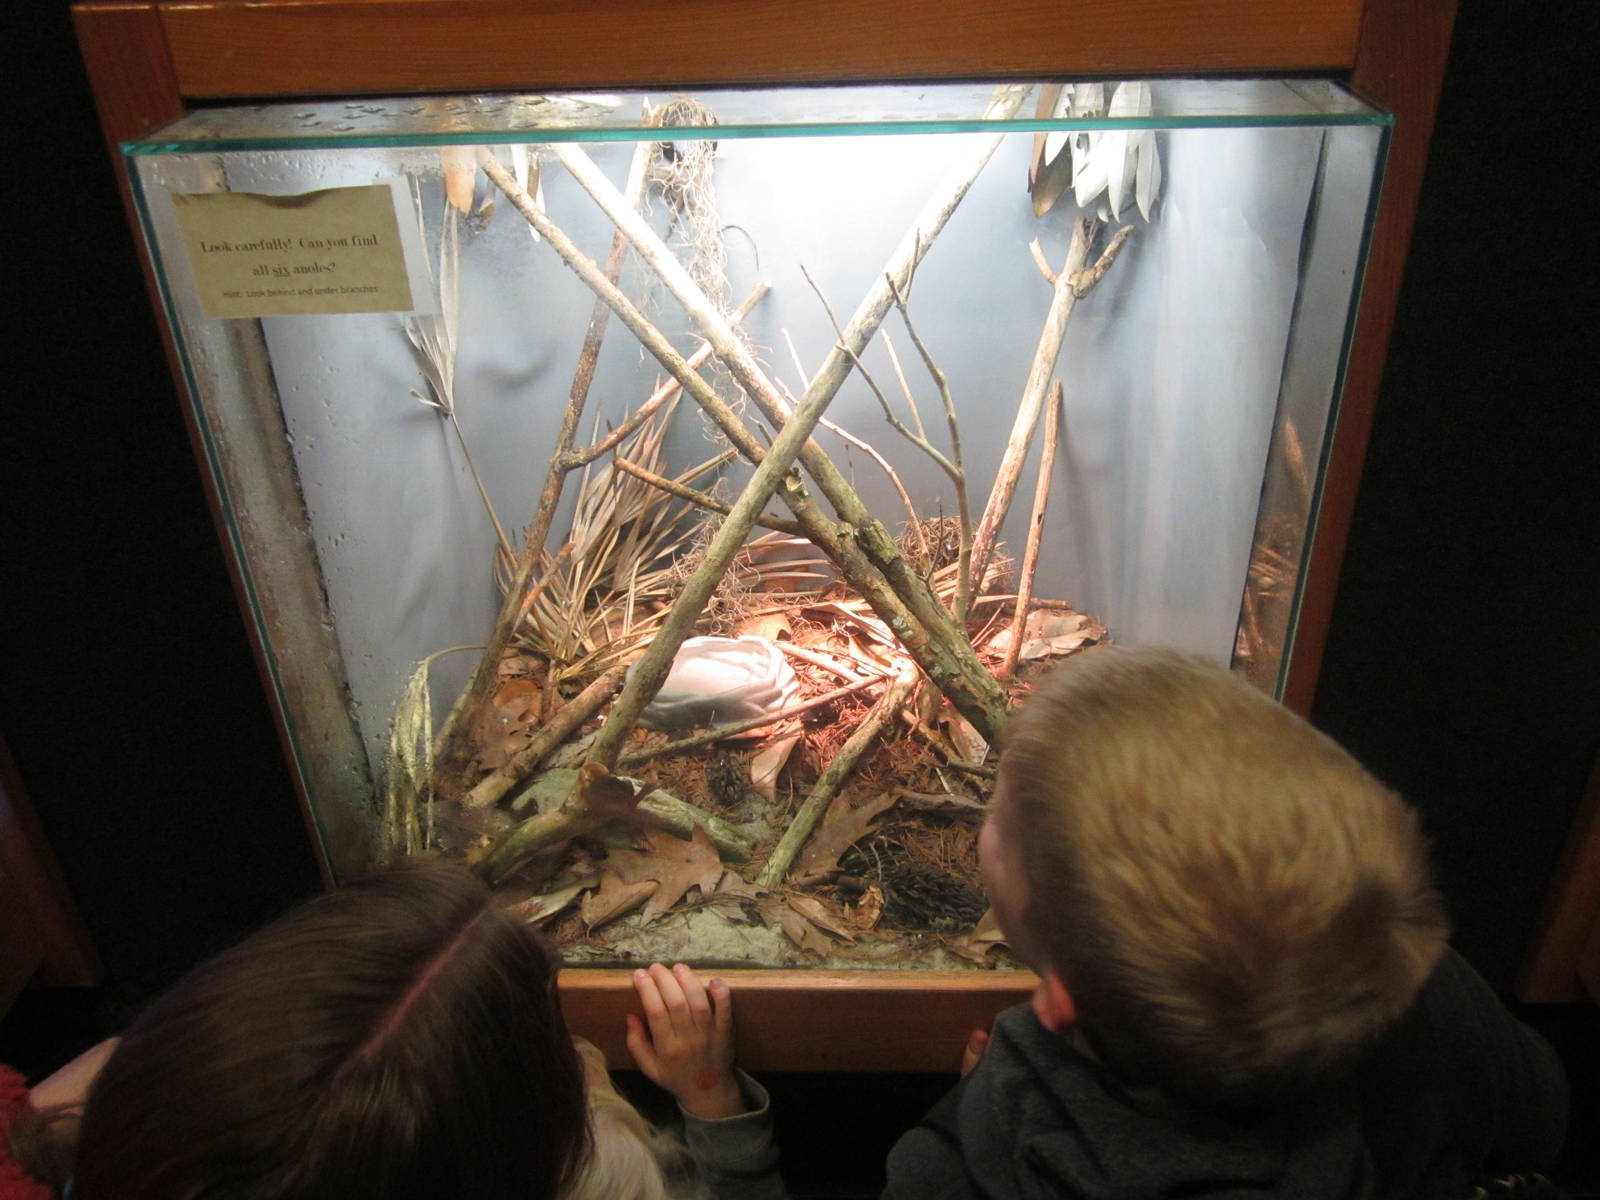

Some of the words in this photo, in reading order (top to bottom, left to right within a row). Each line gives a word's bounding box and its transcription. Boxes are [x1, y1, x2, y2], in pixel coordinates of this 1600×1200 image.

[200, 240, 232, 253] Look
[235, 238, 293, 254] carefully!
[299, 237, 323, 250] Can
[327, 237, 348, 251] you
[351, 234, 378, 247] find
[253, 264, 269, 276] all
[272, 265, 291, 278] six
[293, 262, 336, 275] anoles?
